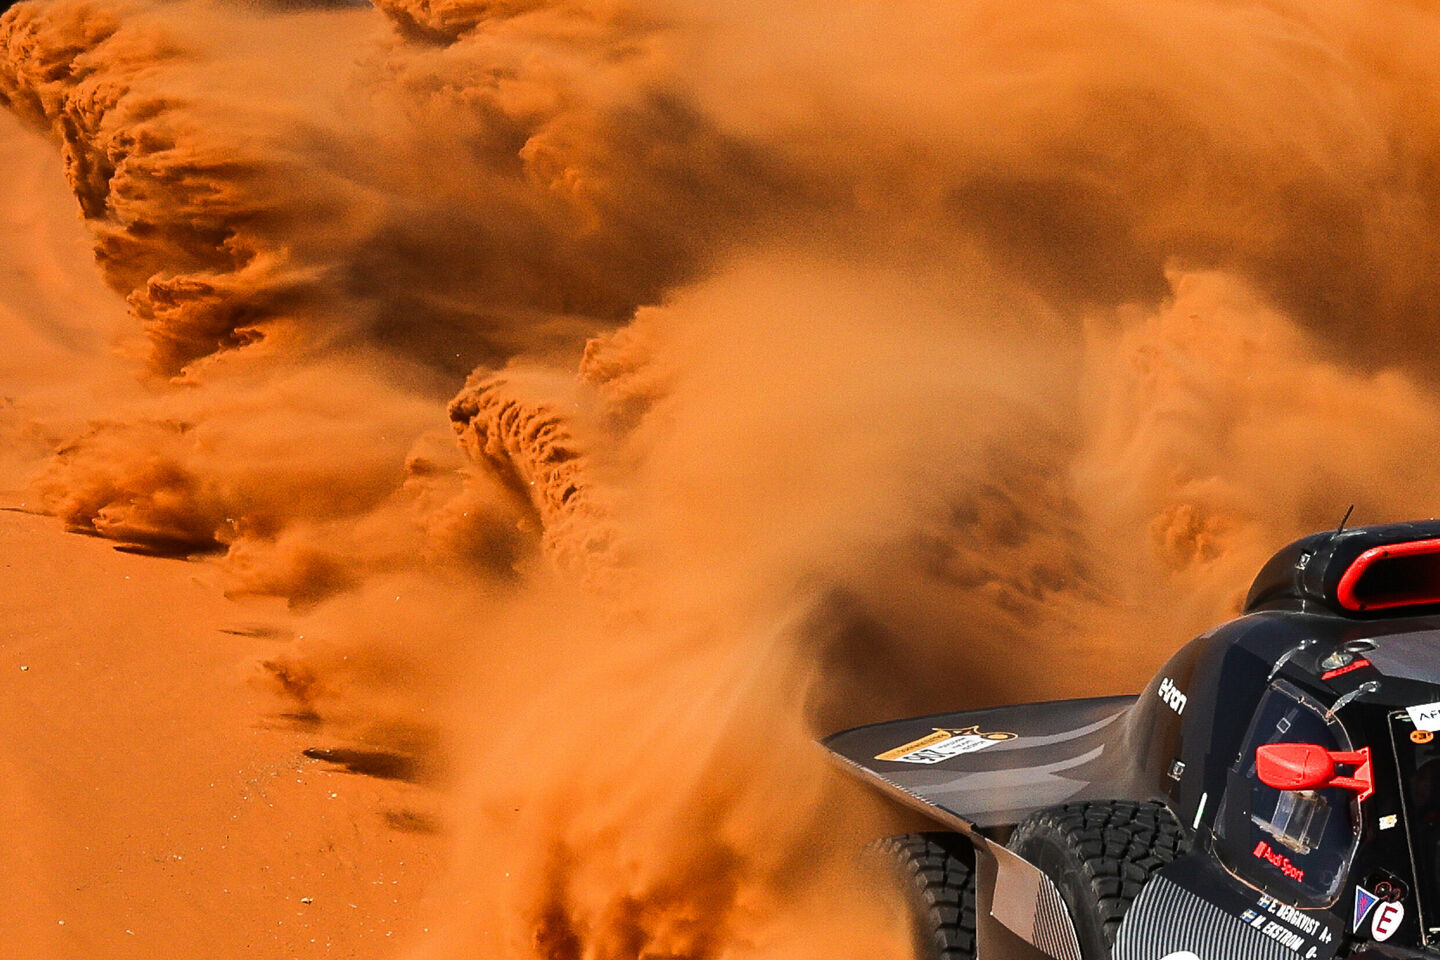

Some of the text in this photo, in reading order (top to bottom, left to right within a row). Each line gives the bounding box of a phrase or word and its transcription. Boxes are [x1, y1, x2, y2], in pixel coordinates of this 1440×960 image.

[1158, 677, 1187, 715] e-tron
[1262, 846, 1304, 882] Audi Sport
[1262, 920, 1305, 951] EKSTROM
[1267, 899, 1332, 944] E. BERGKVIST A+
[1376, 905, 1398, 934] E
